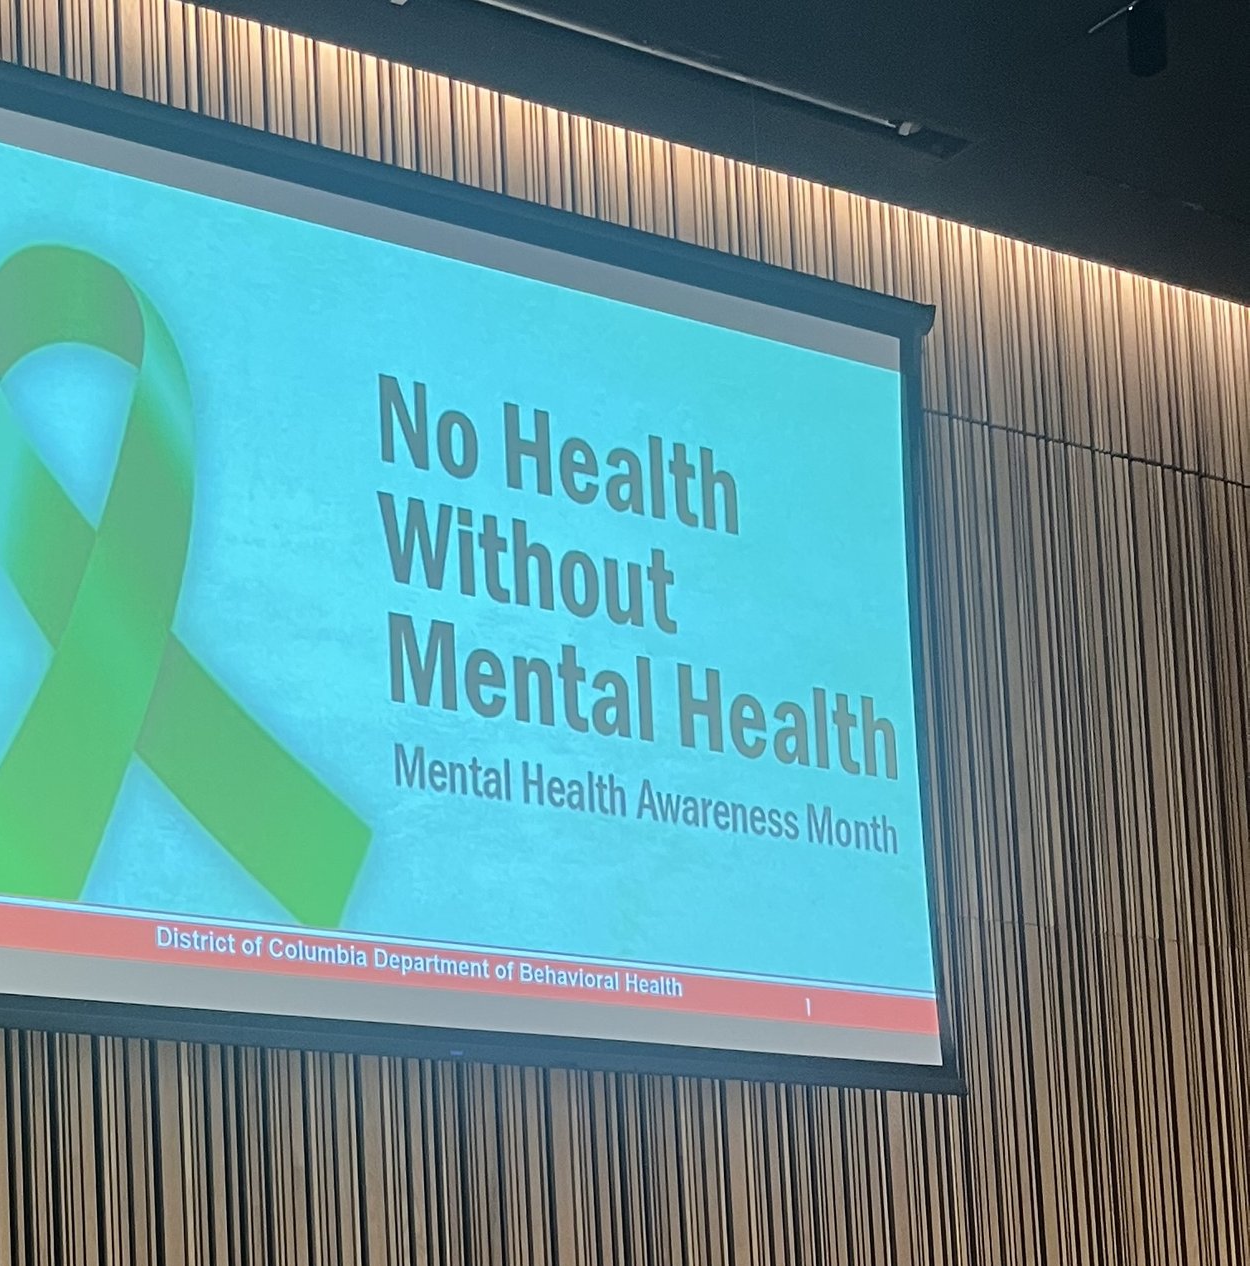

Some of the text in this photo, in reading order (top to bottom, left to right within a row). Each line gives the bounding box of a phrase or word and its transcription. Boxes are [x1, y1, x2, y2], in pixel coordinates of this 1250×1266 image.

[378, 373, 739, 535] No Health
[377, 491, 677, 634] Without
[388, 612, 898, 780] Mental Health
[394, 743, 898, 854] Mental Health Awareness Month
[156, 926, 683, 997] District of Columbia Department of Behavioral Health
